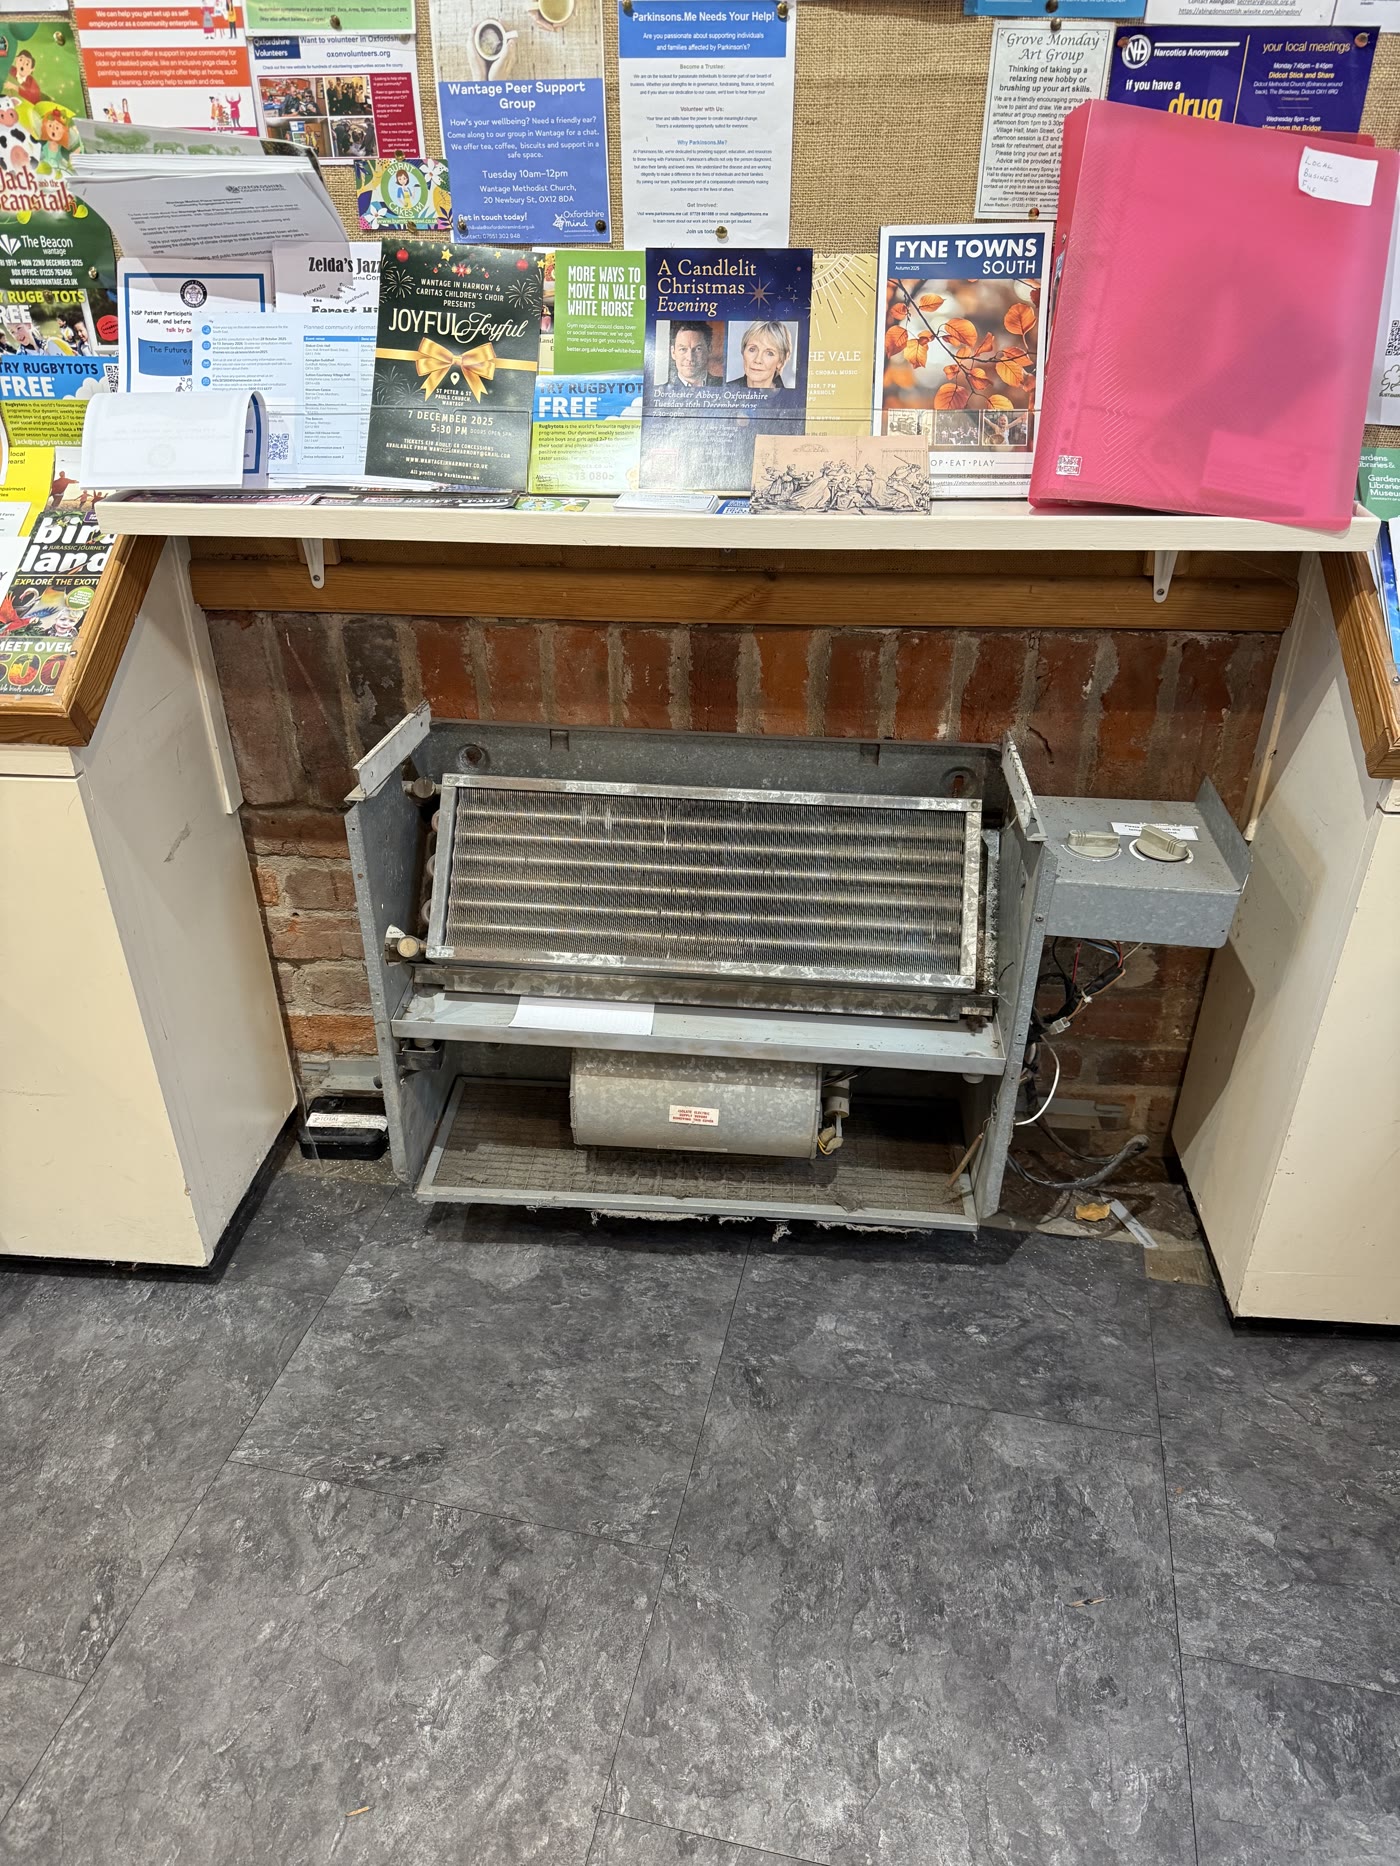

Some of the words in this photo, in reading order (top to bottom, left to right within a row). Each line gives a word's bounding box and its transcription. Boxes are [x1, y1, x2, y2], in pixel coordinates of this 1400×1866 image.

[632, 12, 696, 21] Parkinsons.Me
[700, 12, 726, 20] Needs
[729, 12, 749, 20] Your
[752, 12, 774, 23] Help!
[301, 36, 317, 44] Want
[1007, 32, 1043, 47] Grove
[1046, 32, 1100, 50] Monday
[1154, 48, 1186, 56] Narcotics
[1187, 48, 1229, 58] Anonymous
[1262, 43, 1283, 54] your
[1285, 41, 1307, 51] local
[1309, 41, 1351, 54] meetings
[326, 50, 391, 58] oxonvolunteers.org
[1018, 48, 1041, 60] Art
[1046, 48, 1084, 64] Group
[1008, 65, 1038, 74] Thinking
[1040, 65, 1048, 73] of
[1050, 66, 1071, 74] taking
[1009, 75, 1036, 84] relaxing
[1056, 75, 1076, 84] hobby
[448, 83, 502, 97] Wantage
[506, 83, 533, 93] Peer
[536, 82, 585, 95] Support
[1000, 84, 1030, 93] brushing
[1126, 80, 1133, 90] if
[1134, 81, 1150, 92] you
[1152, 80, 1174, 90] have
[1175, 81, 1181, 90] a
[500, 98, 536, 110] Group
[474, 119, 489, 127] your
[492, 118, 529, 127] wellbeing?
[556, 116, 581, 125] friendly
[387, 161, 416, 176] BURNT
[482, 170, 516, 180] Tuesday
[480, 186, 510, 194] Wantage
[550, 184, 576, 192] Church,
[495, 197, 525, 205] Newbury
[388, 203, 414, 217] CAKES
[414, 202, 425, 212] WI
[564, 210, 604, 218] Oxfordshire
[504, 212, 527, 221] today!
[21, 235, 39, 248] The
[40, 236, 73, 248] Beacon
[43, 248, 66, 256] wantage
[895, 241, 948, 258] FYNE
[955, 238, 1037, 258] TOWNS
[309, 257, 353, 272] Zelda's
[657, 259, 672, 276] A
[678, 258, 756, 276] Candlelit
[982, 260, 1036, 274] SOUTH
[568, 266, 596, 282] MORE
[599, 267, 624, 283] WAYS
[628, 267, 640, 283] TO
[421, 279, 451, 287] WANTAGE
[462, 282, 493, 291] HARMONY
[657, 277, 745, 294] Christmas
[8, 291, 86, 303] RUGBTOTS
[416, 288, 442, 297] CARITAS
[445, 290, 482, 299] CHILDREN'S
[485, 294, 504, 302] CHOIR
[568, 283, 595, 299] MOVE
[598, 284, 609, 299] IN
[612, 284, 636, 300] VALE
[443, 300, 476, 308] PRESENTS
[568, 301, 598, 316] WHITE
[601, 302, 634, 317] HORSE
[657, 296, 718, 317] Evening
[388, 308, 464, 337] JOYFUL
[454, 312, 529, 344] Joyful
[828, 351, 861, 361] VALE
[24, 363, 98, 374] RUGBYTOTS
[653, 390, 693, 398] Dorchester
[695, 391, 721, 400] Abbey,
[724, 391, 768, 401] Oxfordshire
[417, 412, 467, 424] DECEMBER
[471, 416, 493, 426] 2025
[431, 424, 450, 434] 5:30
[455, 427, 468, 435] PM
[20, 544, 112, 572] land
